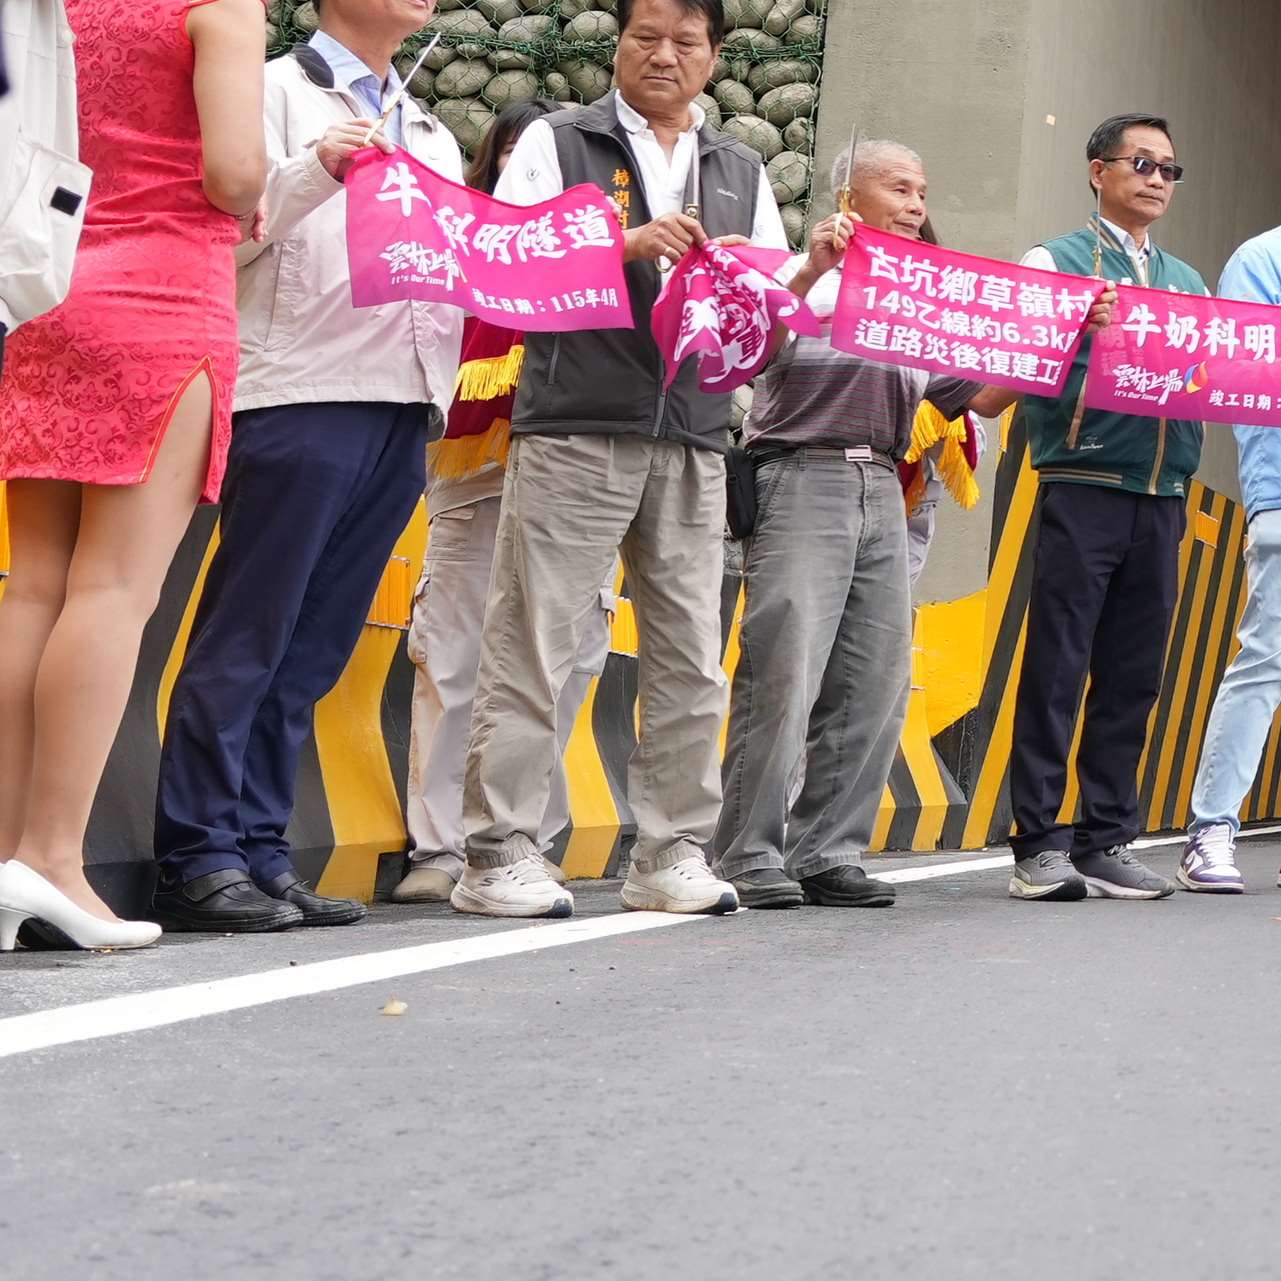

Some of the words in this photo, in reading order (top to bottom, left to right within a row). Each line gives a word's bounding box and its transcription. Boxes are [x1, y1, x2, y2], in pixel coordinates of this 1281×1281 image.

[866, 245, 1094, 322] 古坑鄉草嶺村
[854, 318, 1064, 386] 道路災後復建工
